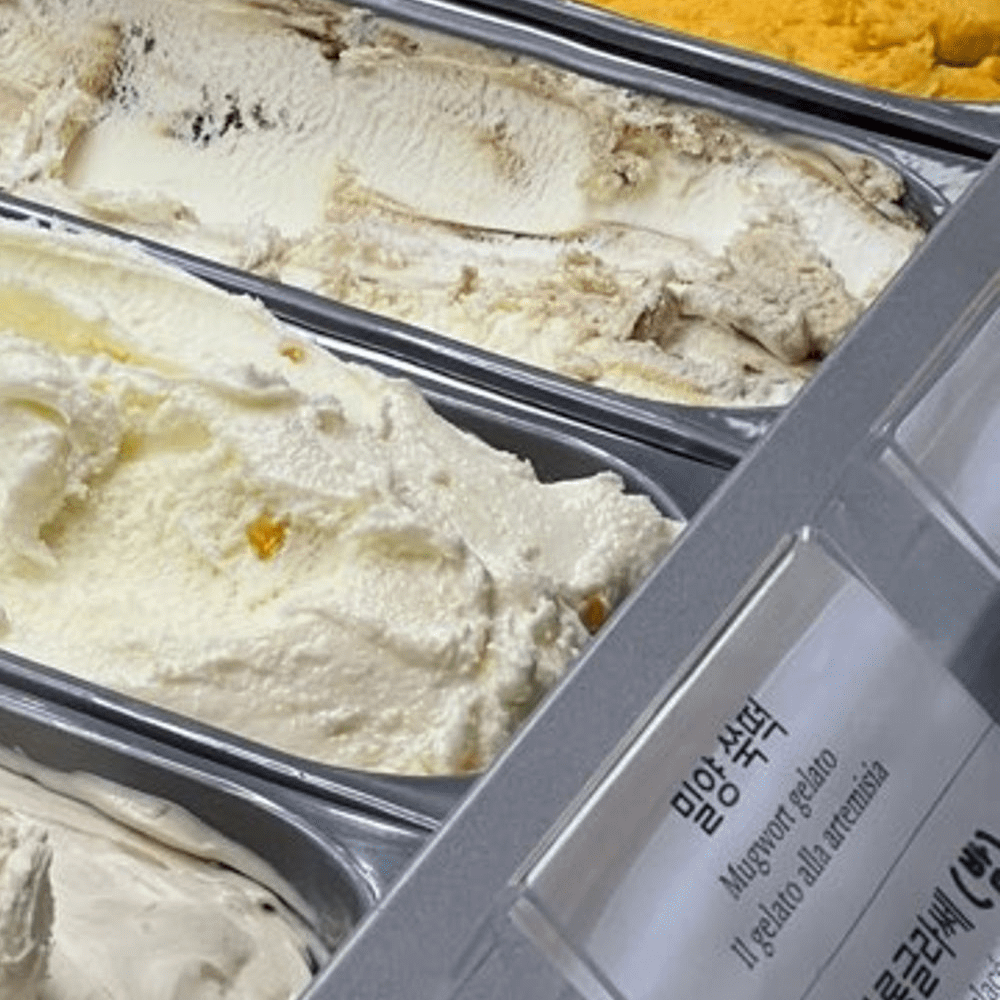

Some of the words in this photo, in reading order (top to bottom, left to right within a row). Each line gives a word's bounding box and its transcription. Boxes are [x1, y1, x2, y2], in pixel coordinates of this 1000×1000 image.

[670, 756, 741, 836] 밀양
[717, 695, 790, 769] 쑥떡
[718, 804, 796, 901] Mugwort
[788, 749, 838, 819] gelato
[750, 881, 804, 958] gelato
[797, 845, 833, 888] alla
[822, 760, 890, 851] artemisia
